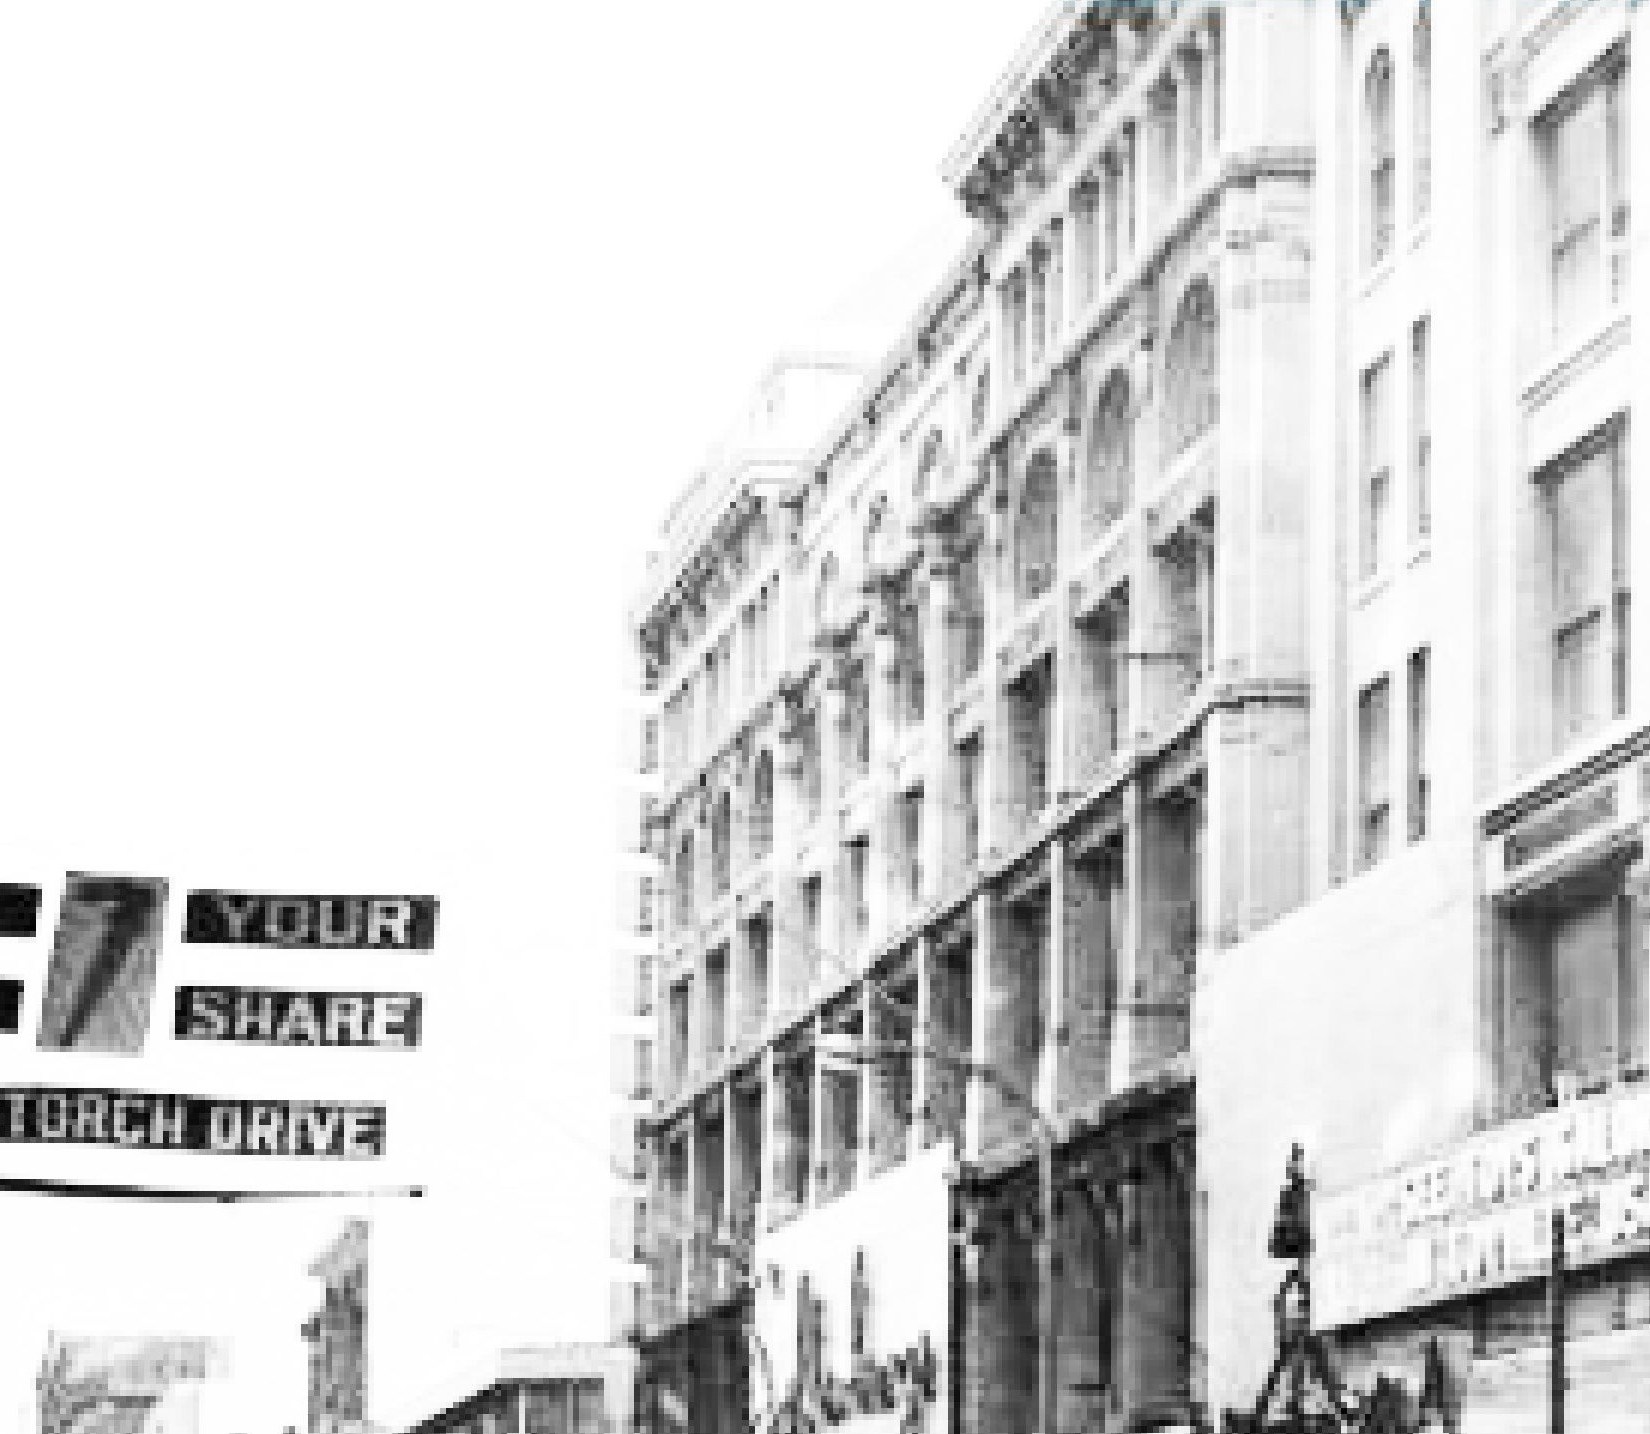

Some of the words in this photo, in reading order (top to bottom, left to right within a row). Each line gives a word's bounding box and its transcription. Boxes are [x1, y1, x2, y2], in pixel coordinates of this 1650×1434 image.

[219, 897, 412, 946] YOUR
[188, 992, 416, 1045] SHARE
[9, 1093, 186, 1148] TORCH
[209, 1102, 386, 1158] DRIVE
